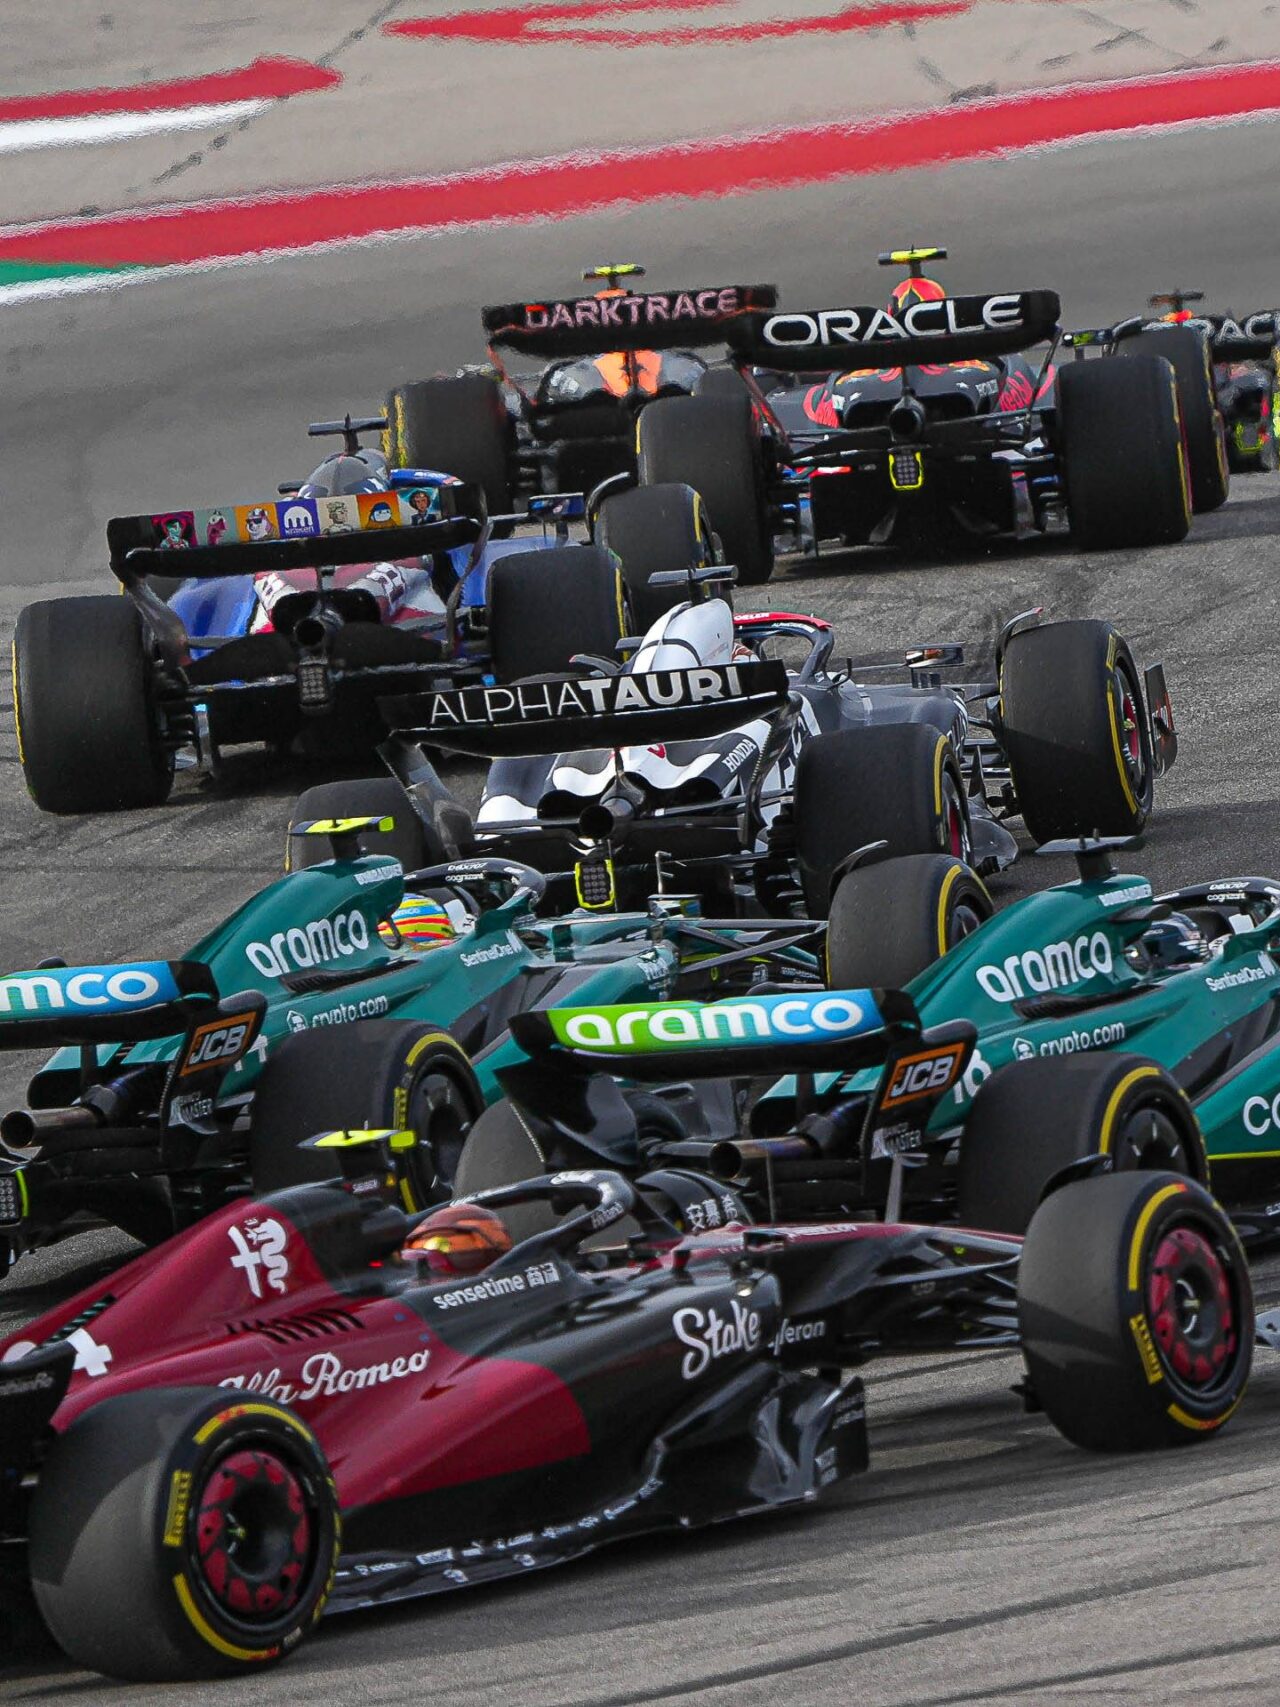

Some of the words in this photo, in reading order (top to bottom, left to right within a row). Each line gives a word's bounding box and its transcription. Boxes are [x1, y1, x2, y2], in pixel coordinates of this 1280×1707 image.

[524, 288, 739, 329] DARKTRACE
[762, 294, 1022, 347] ORACLE
[430, 665, 743, 725] ALPHATAURI
[721, 738, 757, 773] HONDA
[246, 909, 369, 978] aramco
[976, 931, 1113, 1003] aramco
[1205, 965, 1265, 992] SentinelOne
[0, 970, 159, 1012] mco
[188, 1024, 247, 1065] JCB
[564, 998, 864, 1047] aramco
[890, 1056, 954, 1098] JCB
[433, 1273, 525, 1310] sensetime
[672, 1299, 761, 1379] Stake
[299, 1350, 430, 1400] Romeo
